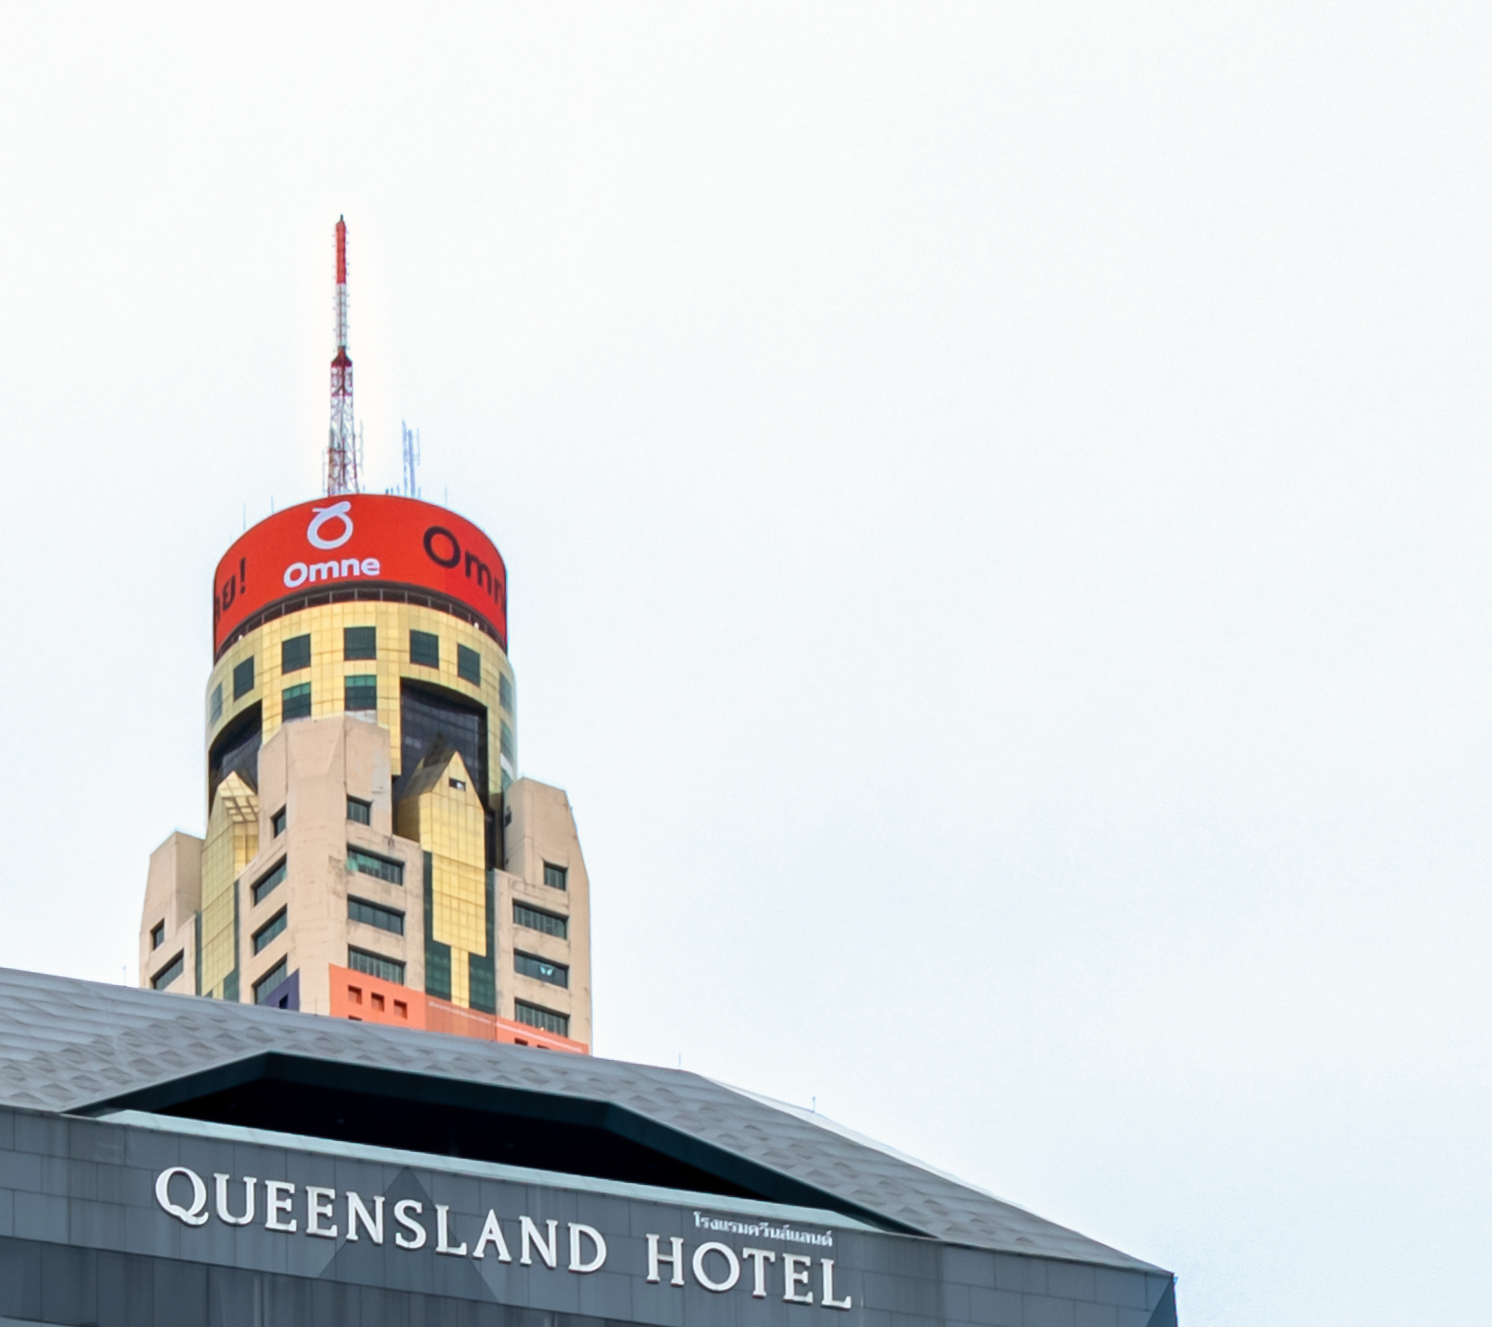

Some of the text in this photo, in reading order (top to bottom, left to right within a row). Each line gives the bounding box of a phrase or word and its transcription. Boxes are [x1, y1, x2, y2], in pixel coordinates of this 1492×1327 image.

[283, 557, 381, 588] Omne
[154, 1165, 852, 1311] QUEENSLAND HOTEL
